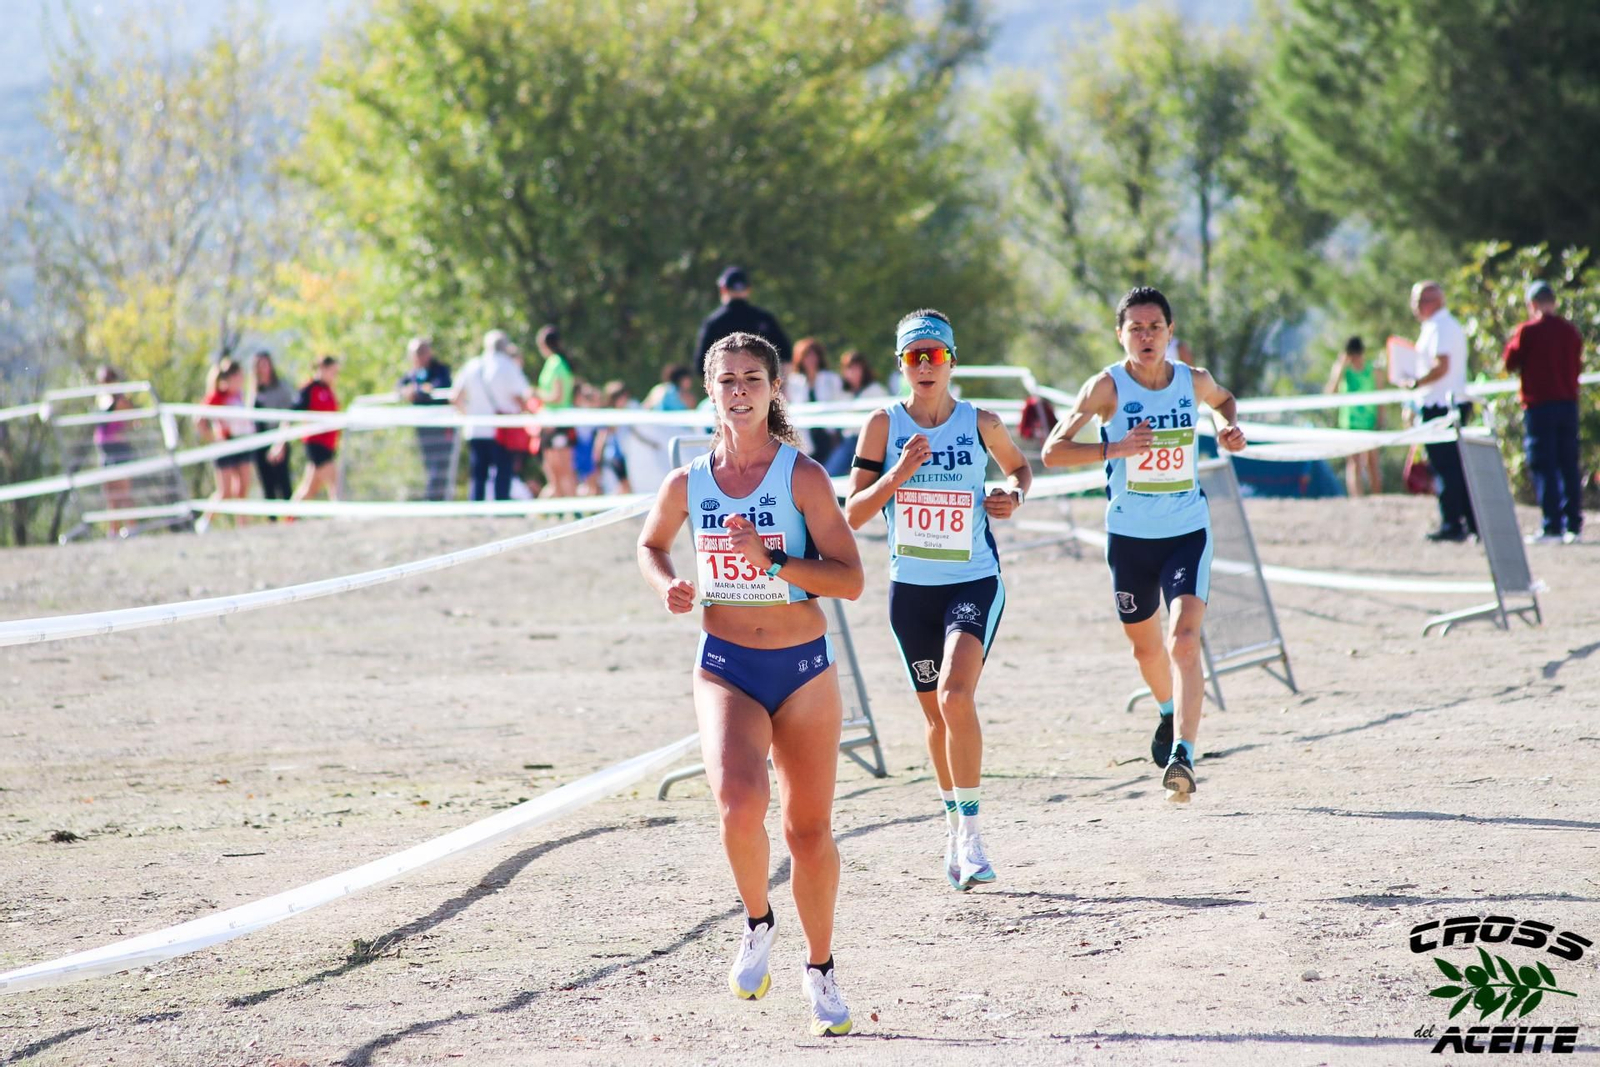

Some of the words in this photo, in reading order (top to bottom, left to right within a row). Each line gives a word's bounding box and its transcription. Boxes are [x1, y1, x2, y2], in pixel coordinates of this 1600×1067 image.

[1138, 446, 1184, 471] 289
[909, 473, 963, 483] ATLETISMO
[904, 492, 917, 503] CROSS
[917, 492, 948, 505] INTERNACIONAL
[948, 494, 957, 506] DEL
[957, 494, 971, 506] ACEITE
[902, 506, 965, 533] 1018
[706, 592, 741, 600] MARQUES
[707, 651, 726, 663] nerja
